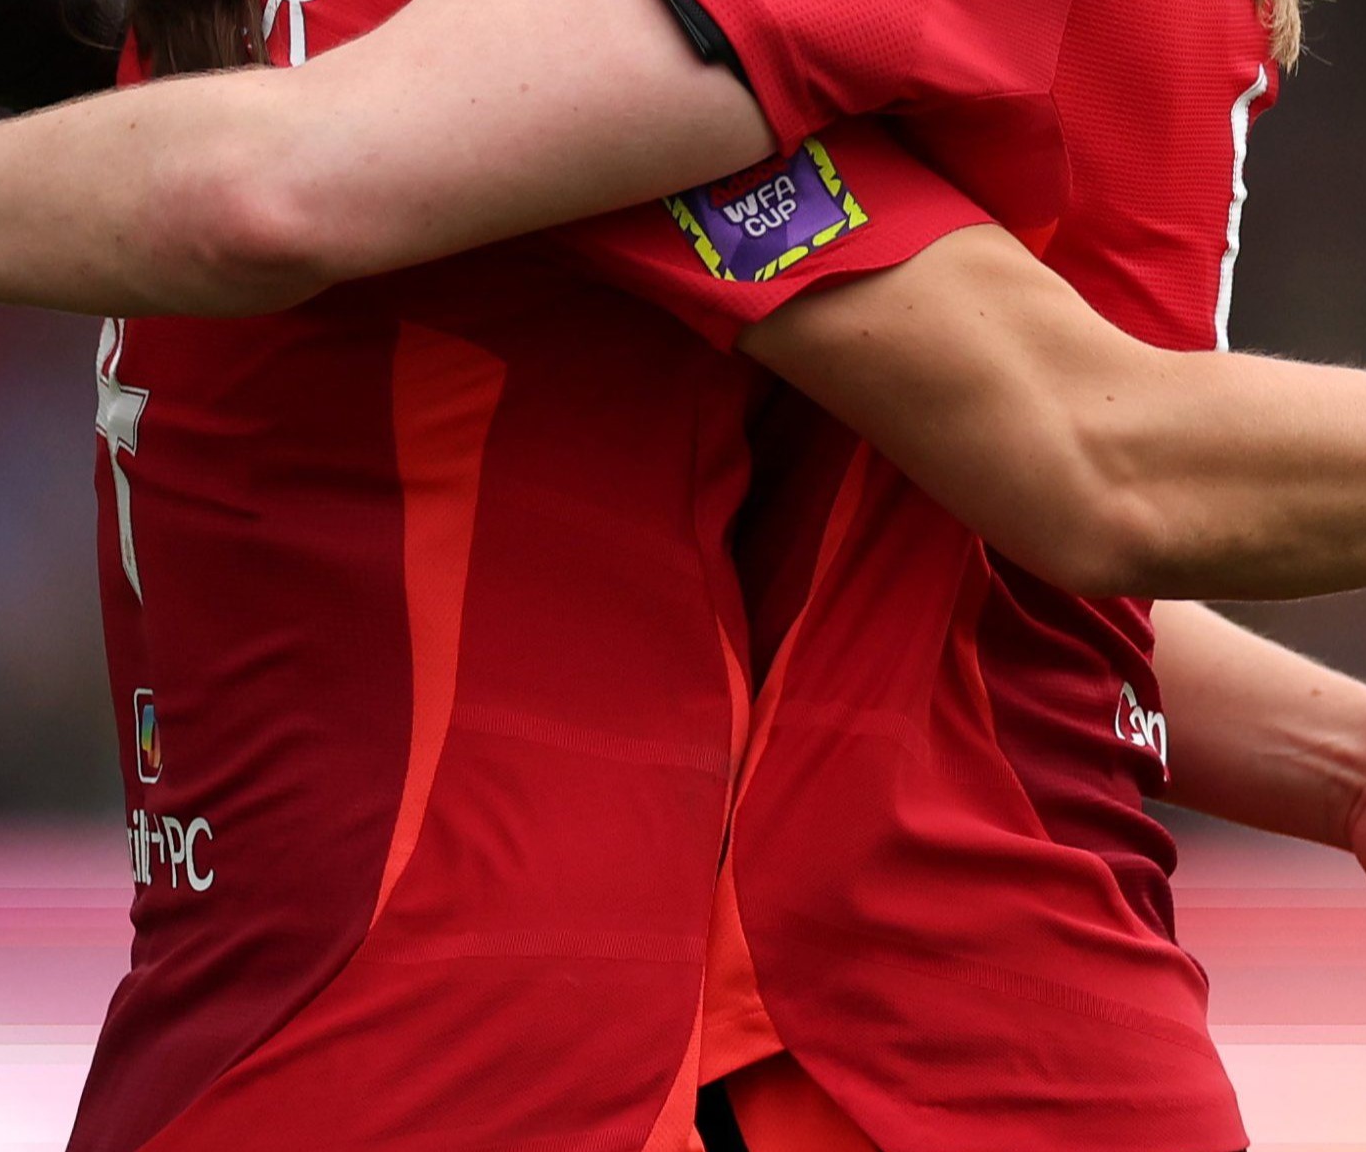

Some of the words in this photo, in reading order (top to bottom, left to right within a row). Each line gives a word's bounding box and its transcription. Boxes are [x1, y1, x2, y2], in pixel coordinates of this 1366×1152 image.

[723, 175, 796, 223] WFA
[744, 198, 797, 237] CUP
[162, 816, 214, 891] PC
